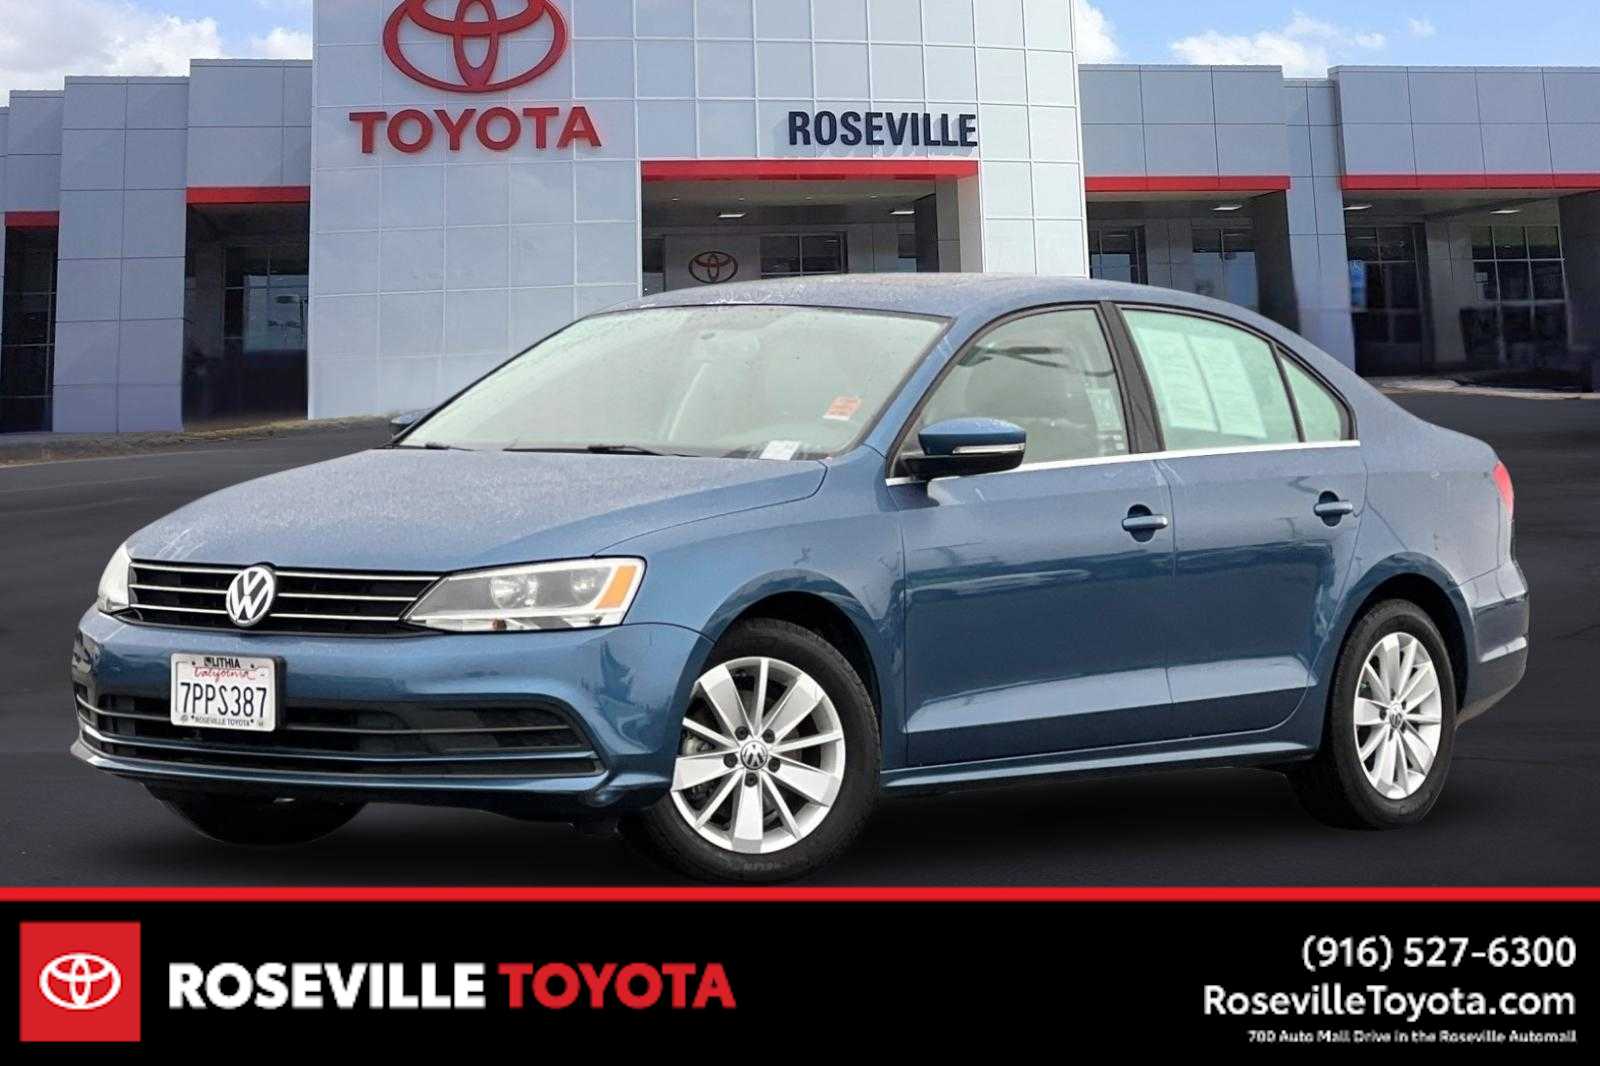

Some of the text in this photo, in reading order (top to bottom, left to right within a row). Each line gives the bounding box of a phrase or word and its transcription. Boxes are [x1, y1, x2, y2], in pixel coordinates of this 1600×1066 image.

[350, 106, 602, 154] TOYOTA
[788, 111, 978, 147] ROSEVILLE
[226, 566, 275, 625] VW
[210, 657, 241, 669] LITHIA
[180, 682, 267, 718] 7PPS387
[227, 717, 251, 727] TOYOTA
